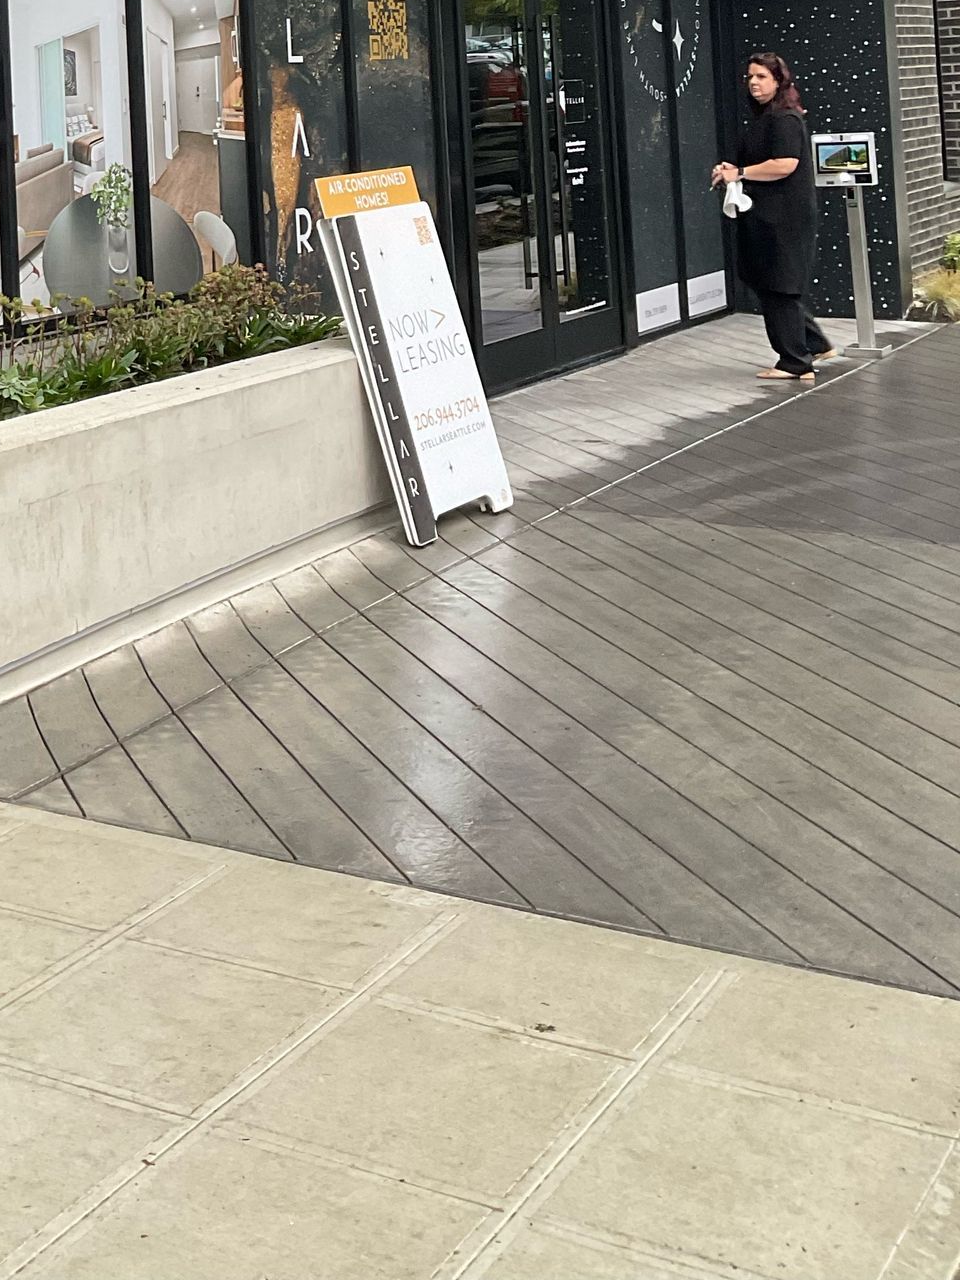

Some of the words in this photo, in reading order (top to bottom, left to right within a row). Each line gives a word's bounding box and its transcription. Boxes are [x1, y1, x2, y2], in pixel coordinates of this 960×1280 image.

[328, 172, 407, 195] AIR-CONDITIONED
[354, 191, 390, 209] HOMES!
[388, 310, 429, 342] NOW
[396, 332, 466, 373] LEASING
[350, 251, 420, 497] STELLAR
[413, 396, 481, 431] 206.944.3704
[420, 421, 486, 451] STELLARSEATTLE.COM
